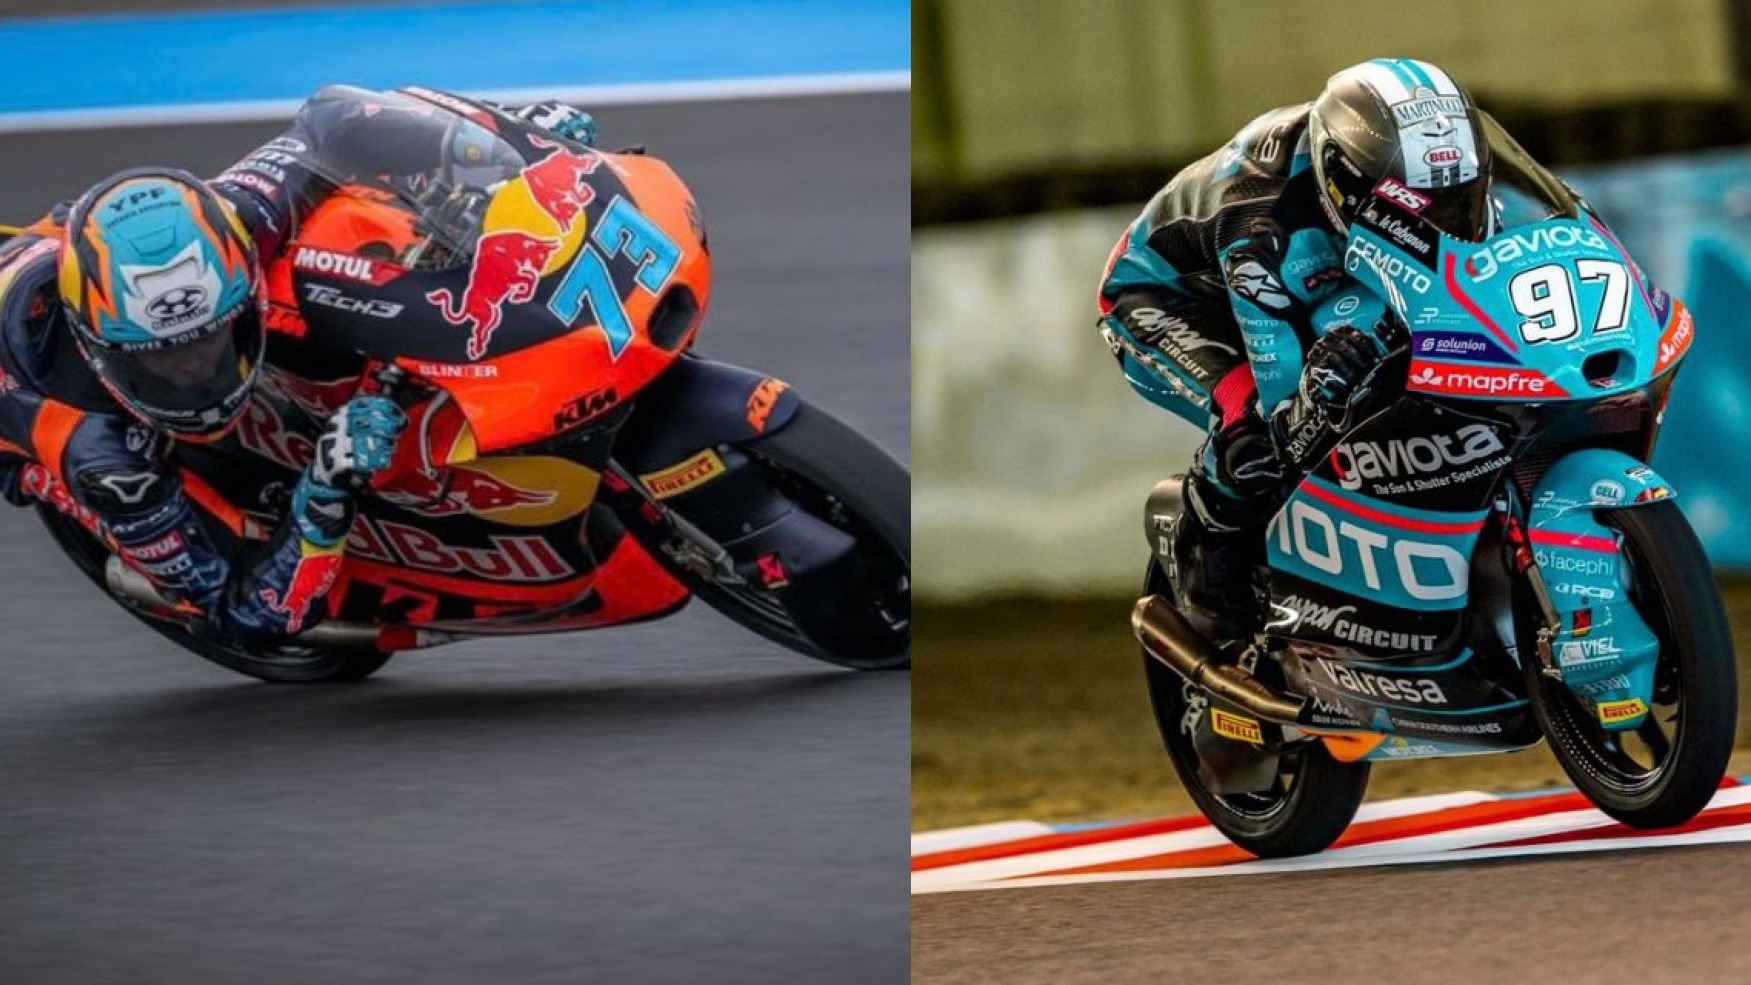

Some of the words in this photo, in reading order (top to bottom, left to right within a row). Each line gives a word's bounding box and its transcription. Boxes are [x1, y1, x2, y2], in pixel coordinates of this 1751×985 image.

[1429, 150, 1461, 163] BELL
[1378, 180, 1425, 211] WRS
[293, 246, 373, 281] MOTUL
[1464, 224, 1611, 283] gaviota
[547, 194, 683, 364] 73
[1508, 257, 1632, 346] 97
[1158, 338, 1209, 380] CIRCUIT
[1437, 337, 1487, 353] solunion
[1446, 371, 1545, 393] mapfre
[553, 385, 620, 428] KTM
[646, 456, 715, 495] PIRELLI
[1329, 423, 1505, 491] gaviota
[1373, 484, 1390, 495] The
[1389, 482, 1407, 494] Sun
[1405, 481, 1415, 492] &
[1413, 475, 1451, 491] Shutter
[1450, 455, 1512, 483] Specialists
[378, 519, 577, 582] Bull
[1550, 551, 1614, 577] facephi
[1333, 618, 1438, 651] CIRCUIT
[1316, 656, 1448, 705] Valresa
[1216, 712, 1261, 742] PIRELLI
